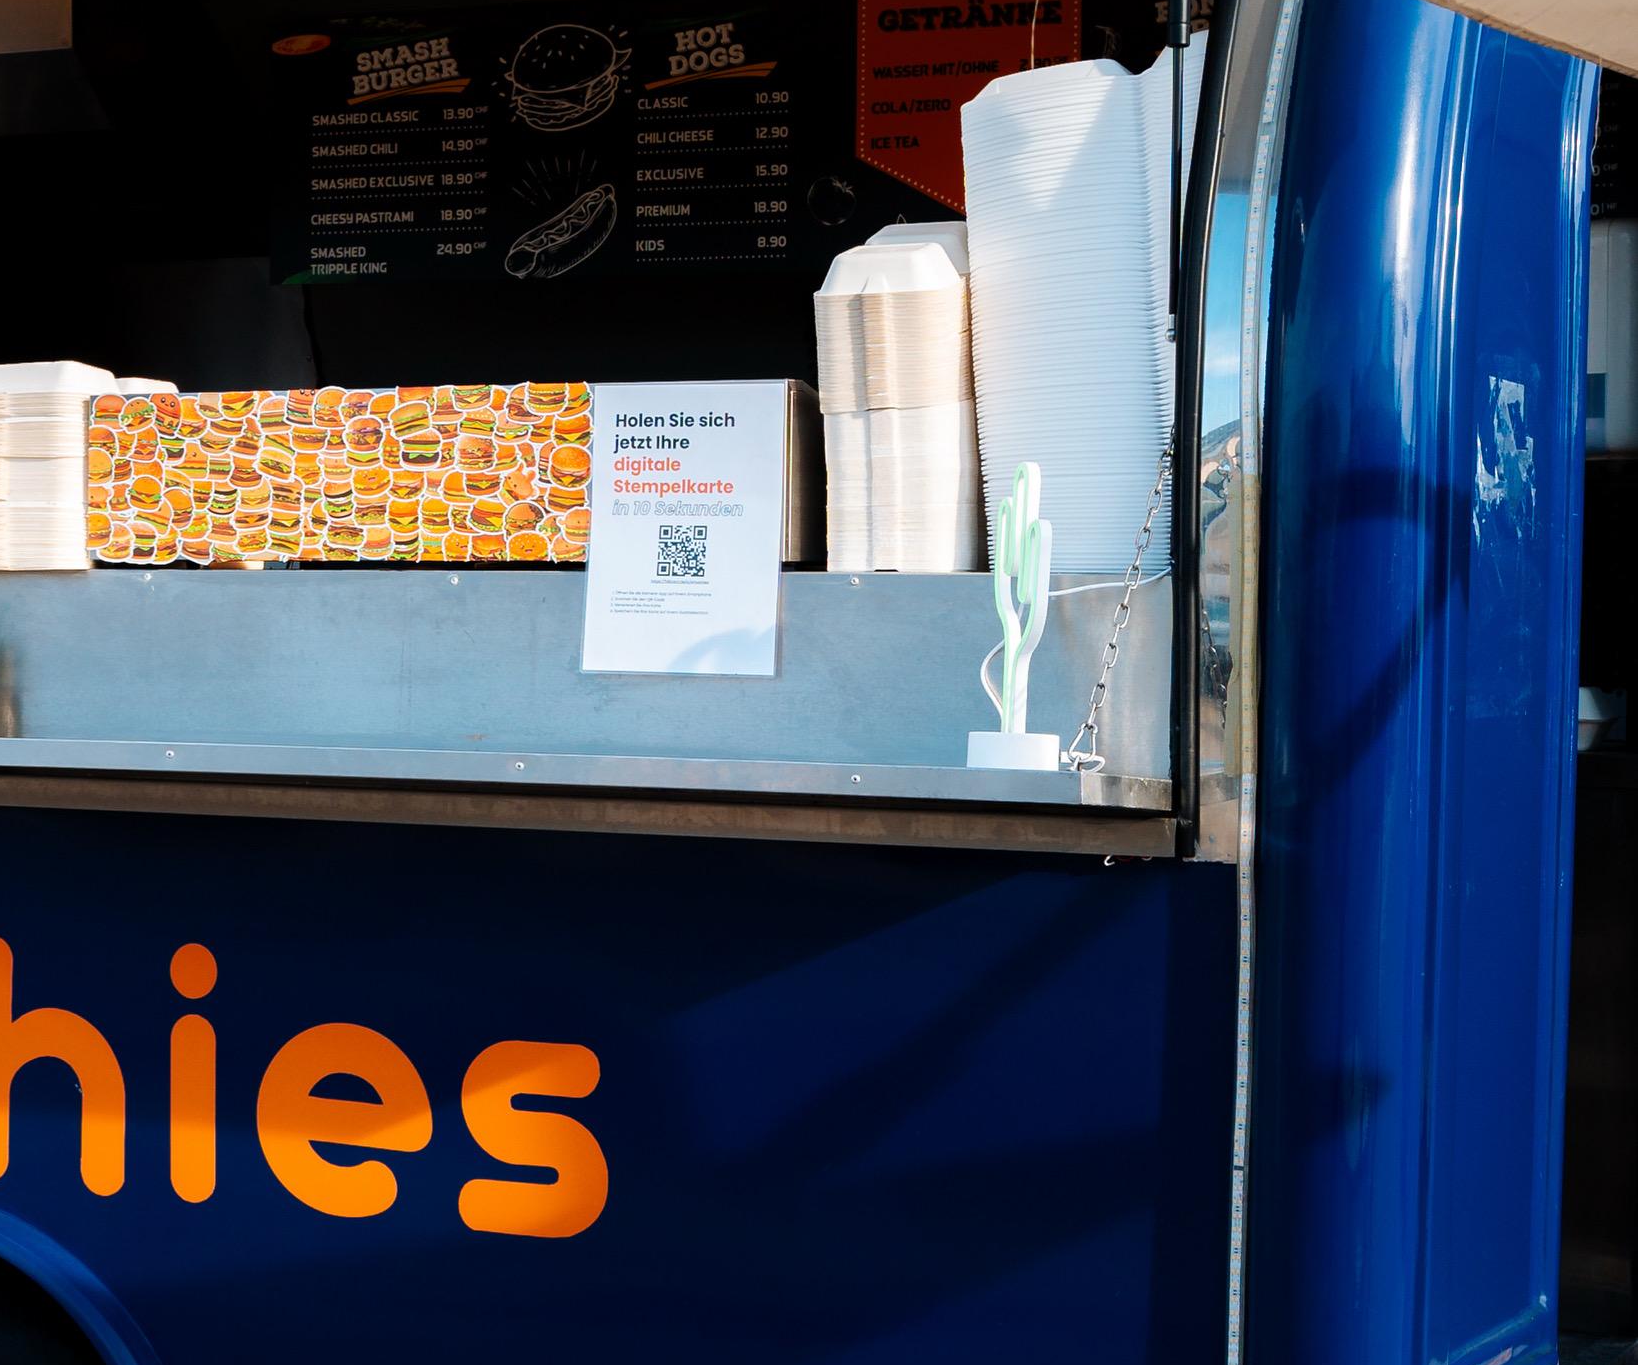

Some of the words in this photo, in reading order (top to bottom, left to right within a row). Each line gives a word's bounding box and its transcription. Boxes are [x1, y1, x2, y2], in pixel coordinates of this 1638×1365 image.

[674, 22, 734, 52] HOT
[356, 36, 450, 73] SMASH
[668, 44, 746, 77] DOGS
[352, 58, 461, 96] BURGER
[872, 64, 928, 80] WASSER
[932, 60, 999, 77] MIT/OHNE
[637, 96, 689, 110] CLASSIC
[755, 91, 789, 104] 10.90
[871, 98, 951, 116] COLA/ZERO
[312, 113, 368, 127] SMASHED
[370, 110, 420, 124] CLASSIC
[442, 107, 474, 121] 13.90
[637, 131, 667, 145] CHILI
[668, 130, 714, 143] CHEESE
[755, 126, 789, 140] 12.90
[870, 136, 891, 150] ICE
[895, 135, 919, 148] TEA
[311, 144, 368, 158] SMASHED
[370, 143, 398, 155] CHILI
[441, 139, 474, 152] 14.90
[311, 177, 367, 191] SMASHED
[369, 174, 435, 188] EXCLUSIVE
[441, 173, 473, 186] 18.90
[636, 167, 705, 182] EXCLUSIVE
[755, 164, 788, 177] 15.90
[310, 212, 354, 225] CHEESY
[355, 211, 414, 224] PASTRAMI
[440, 208, 472, 221] 18.90
[636, 204, 691, 218] PREMIUM
[753, 200, 788, 214] 18.90
[310, 245, 367, 259] SMASHED
[436, 242, 472, 256] 24.90
[635, 239, 665, 252] KIDS
[756, 235, 787, 248] 8.90
[310, 261, 358, 275] TRIPPLE
[359, 261, 388, 274] KING
[615, 413, 665, 428] Holen
[668, 413, 696, 428] Sie
[698, 412, 735, 427] sich
[613, 435, 652, 454] jetzt
[655, 435, 690, 450] Ihre
[614, 457, 681, 476] digitale
[614, 479, 735, 498] Stempelkarte
[612, 500, 630, 516] in
[633, 501, 651, 516] 10
[654, 500, 744, 517] Sekunden
